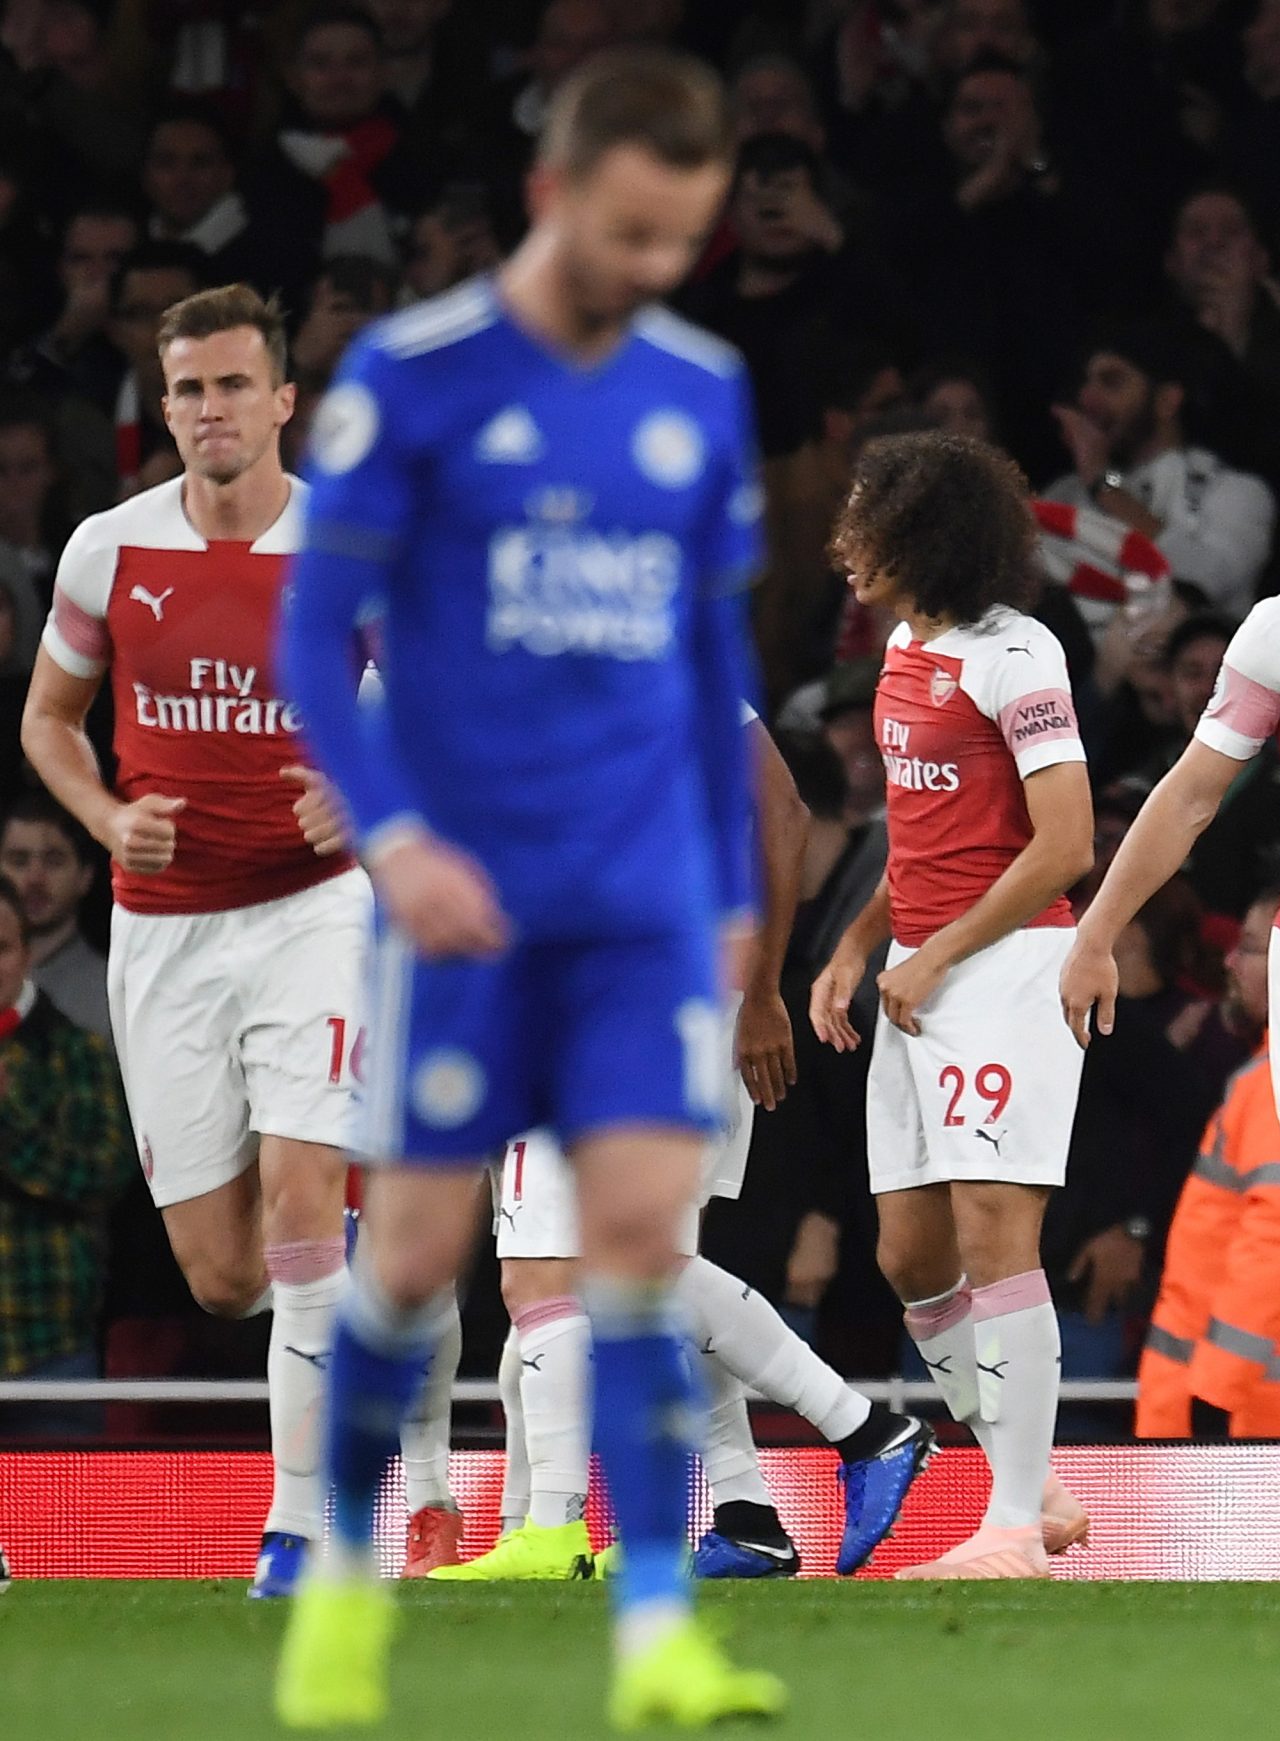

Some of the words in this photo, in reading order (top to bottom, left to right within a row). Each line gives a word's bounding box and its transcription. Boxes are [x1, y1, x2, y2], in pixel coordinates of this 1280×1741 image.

[189, 657, 256, 697] Fly
[133, 681, 305, 735] Emirate
[1018, 700, 1057, 721] VISIT
[882, 717, 910, 753] Fly
[1014, 715, 1072, 742] RWANDA
[938, 1063, 1012, 1127] 29
